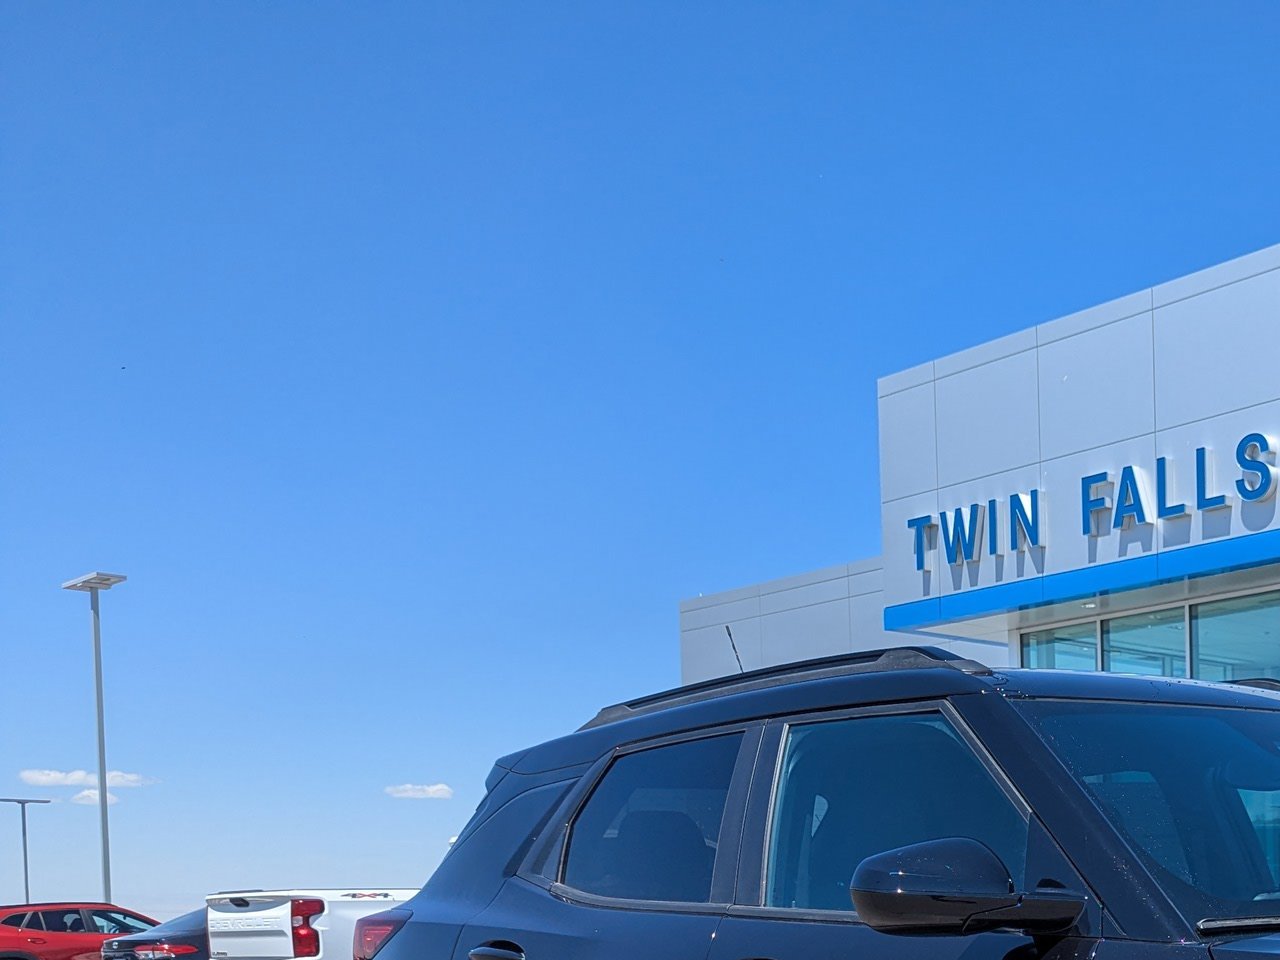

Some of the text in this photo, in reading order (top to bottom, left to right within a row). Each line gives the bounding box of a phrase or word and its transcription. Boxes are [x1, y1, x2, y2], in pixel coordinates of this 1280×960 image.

[907, 432, 1276, 571] TWIN FALLS
[209, 917, 281, 930] CHEVROLET
